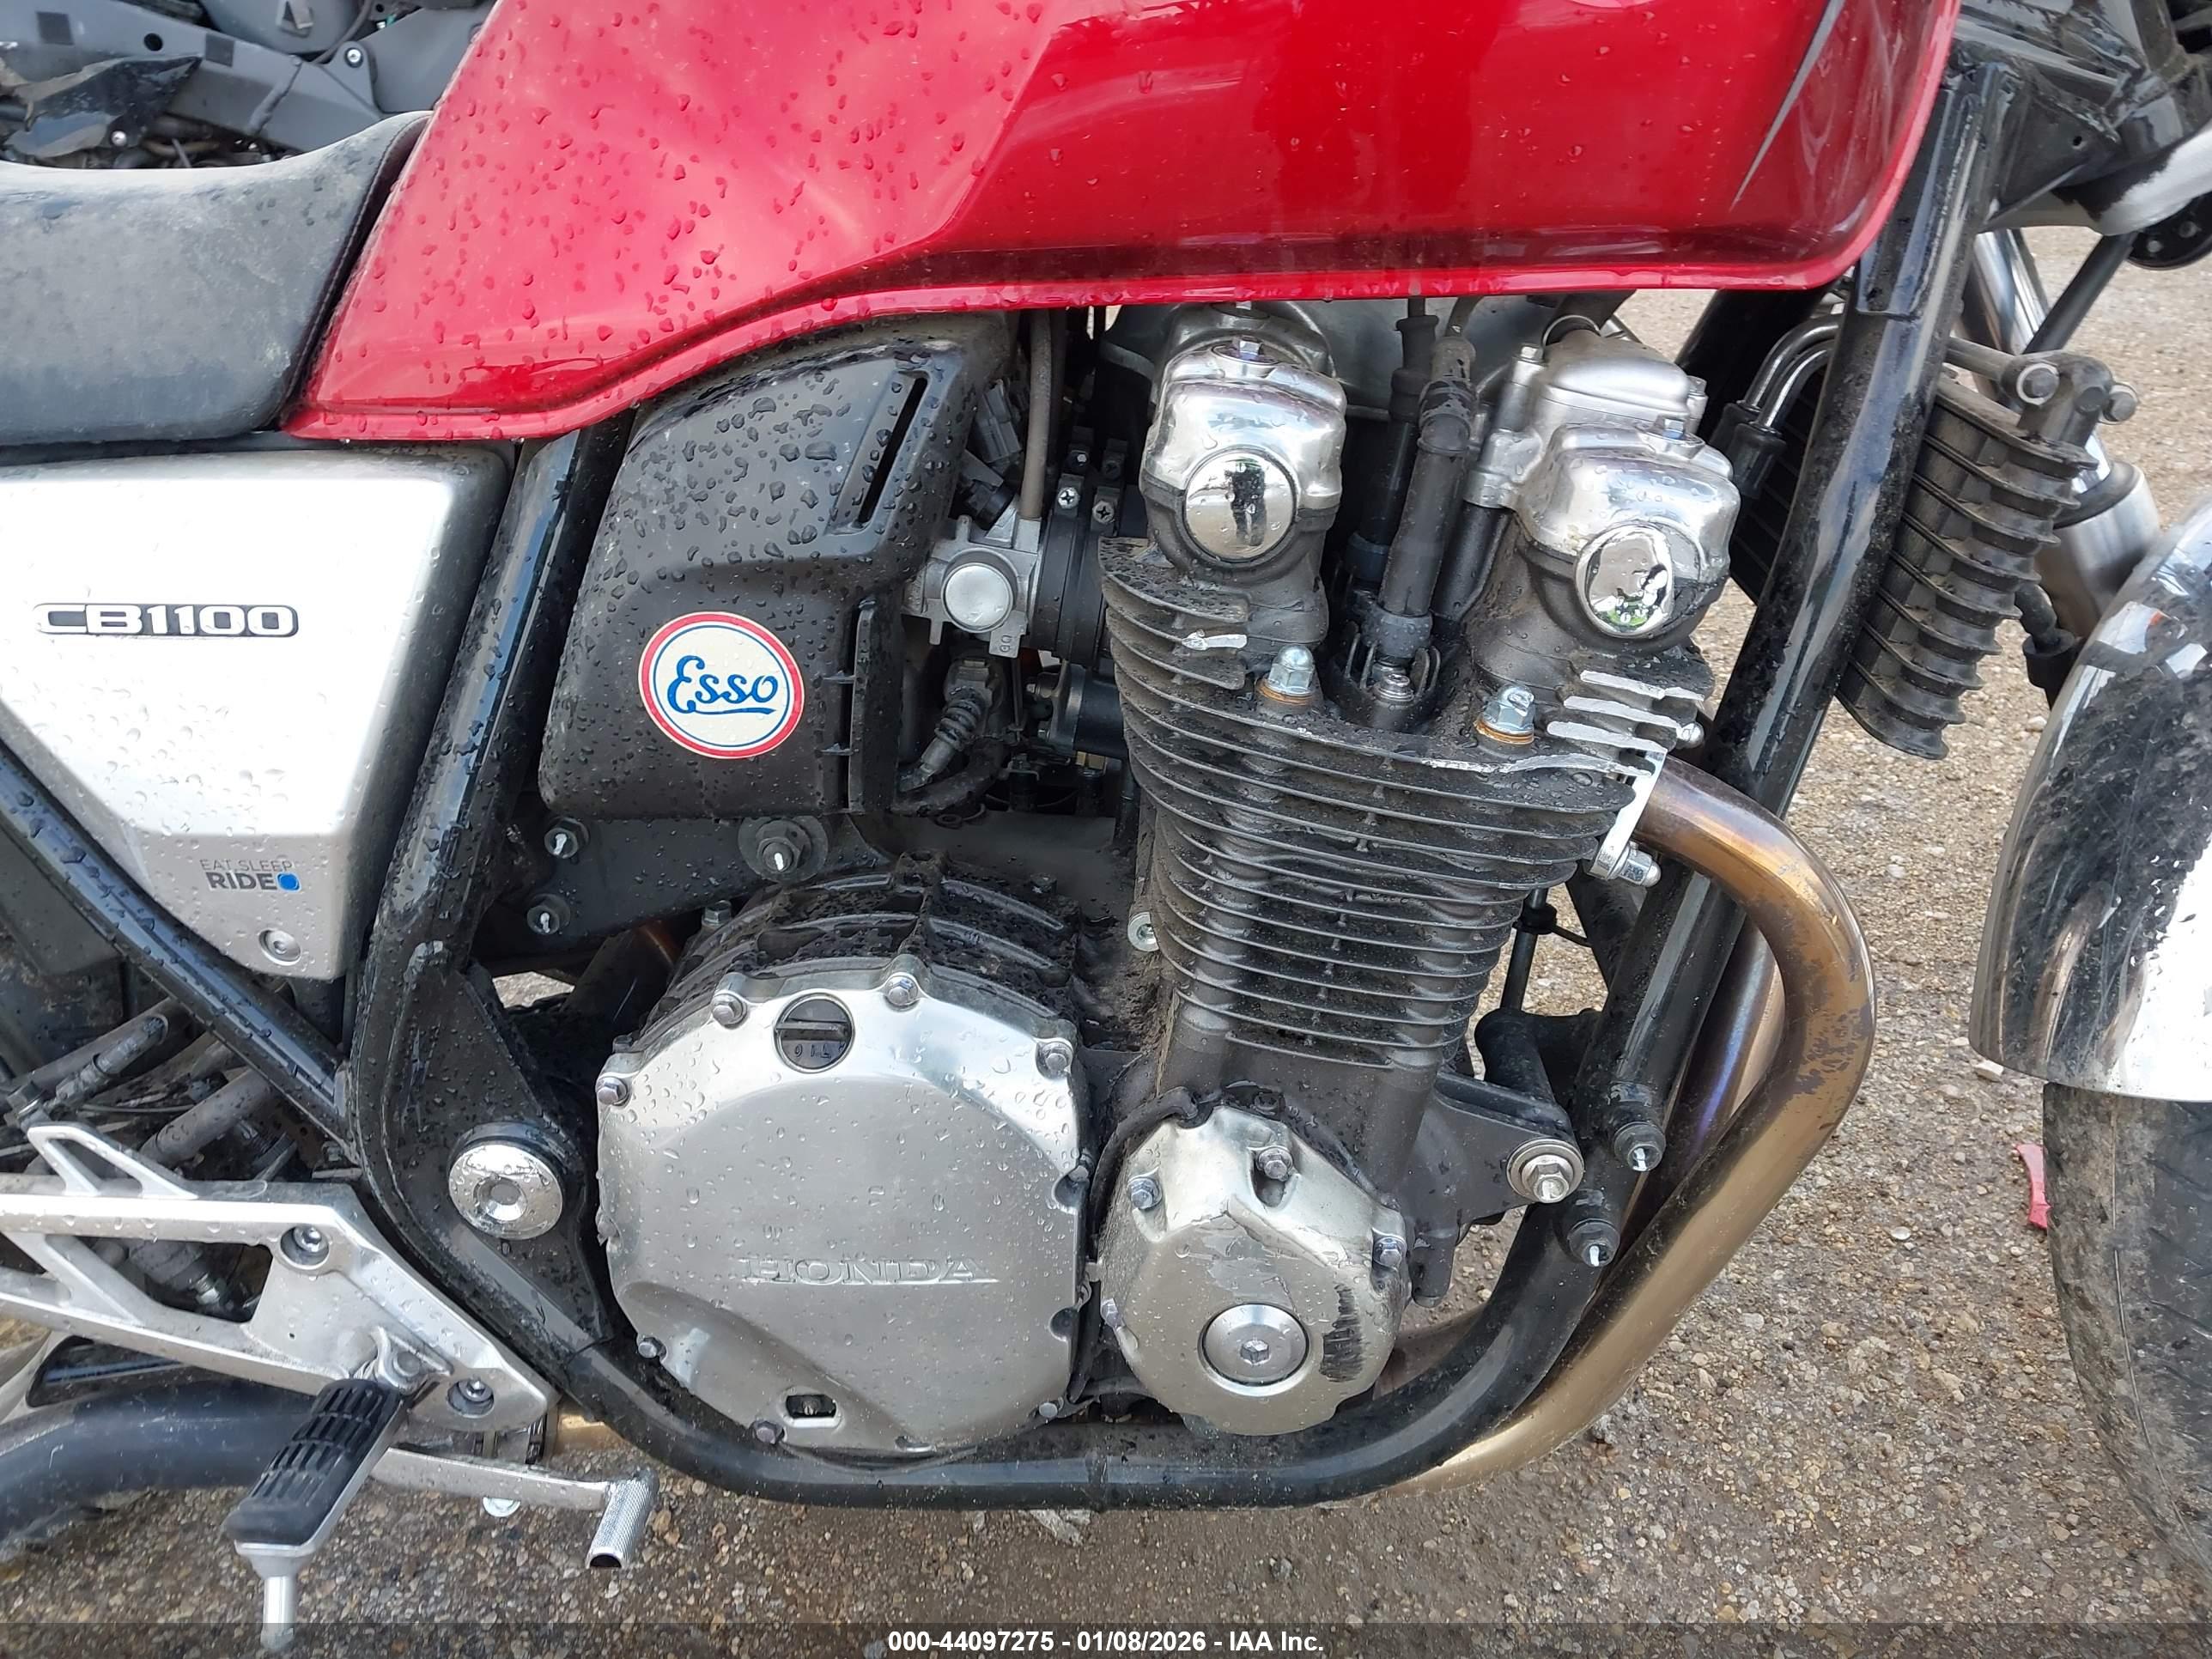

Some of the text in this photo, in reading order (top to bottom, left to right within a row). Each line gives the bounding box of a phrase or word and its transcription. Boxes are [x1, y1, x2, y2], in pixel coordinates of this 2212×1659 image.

[34, 604, 296, 636] CB1100
[666, 654, 779, 715] Esso
[205, 872, 277, 890] RIDE
[738, 1258, 1000, 1285] HONDA
